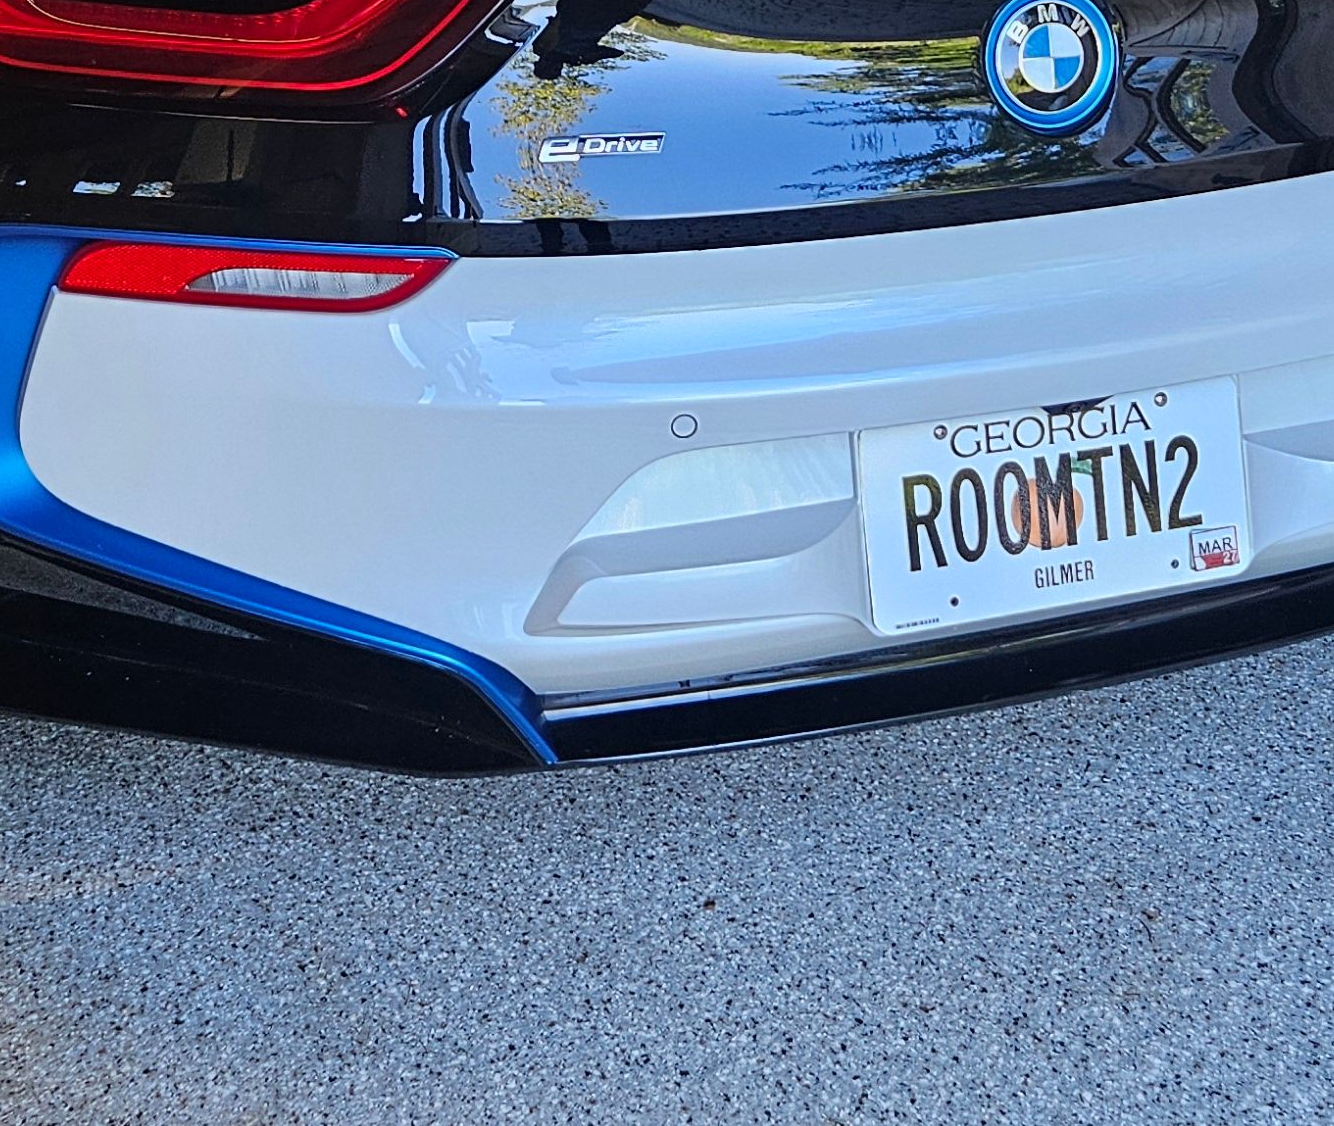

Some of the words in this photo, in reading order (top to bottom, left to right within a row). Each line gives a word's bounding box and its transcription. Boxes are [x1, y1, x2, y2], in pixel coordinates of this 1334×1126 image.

[1006, 3, 1091, 44] BMW
[949, 401, 1152, 459] GEORGIA
[1198, 536, 1234, 556] MAR
[1033, 559, 1096, 589] GILMER
